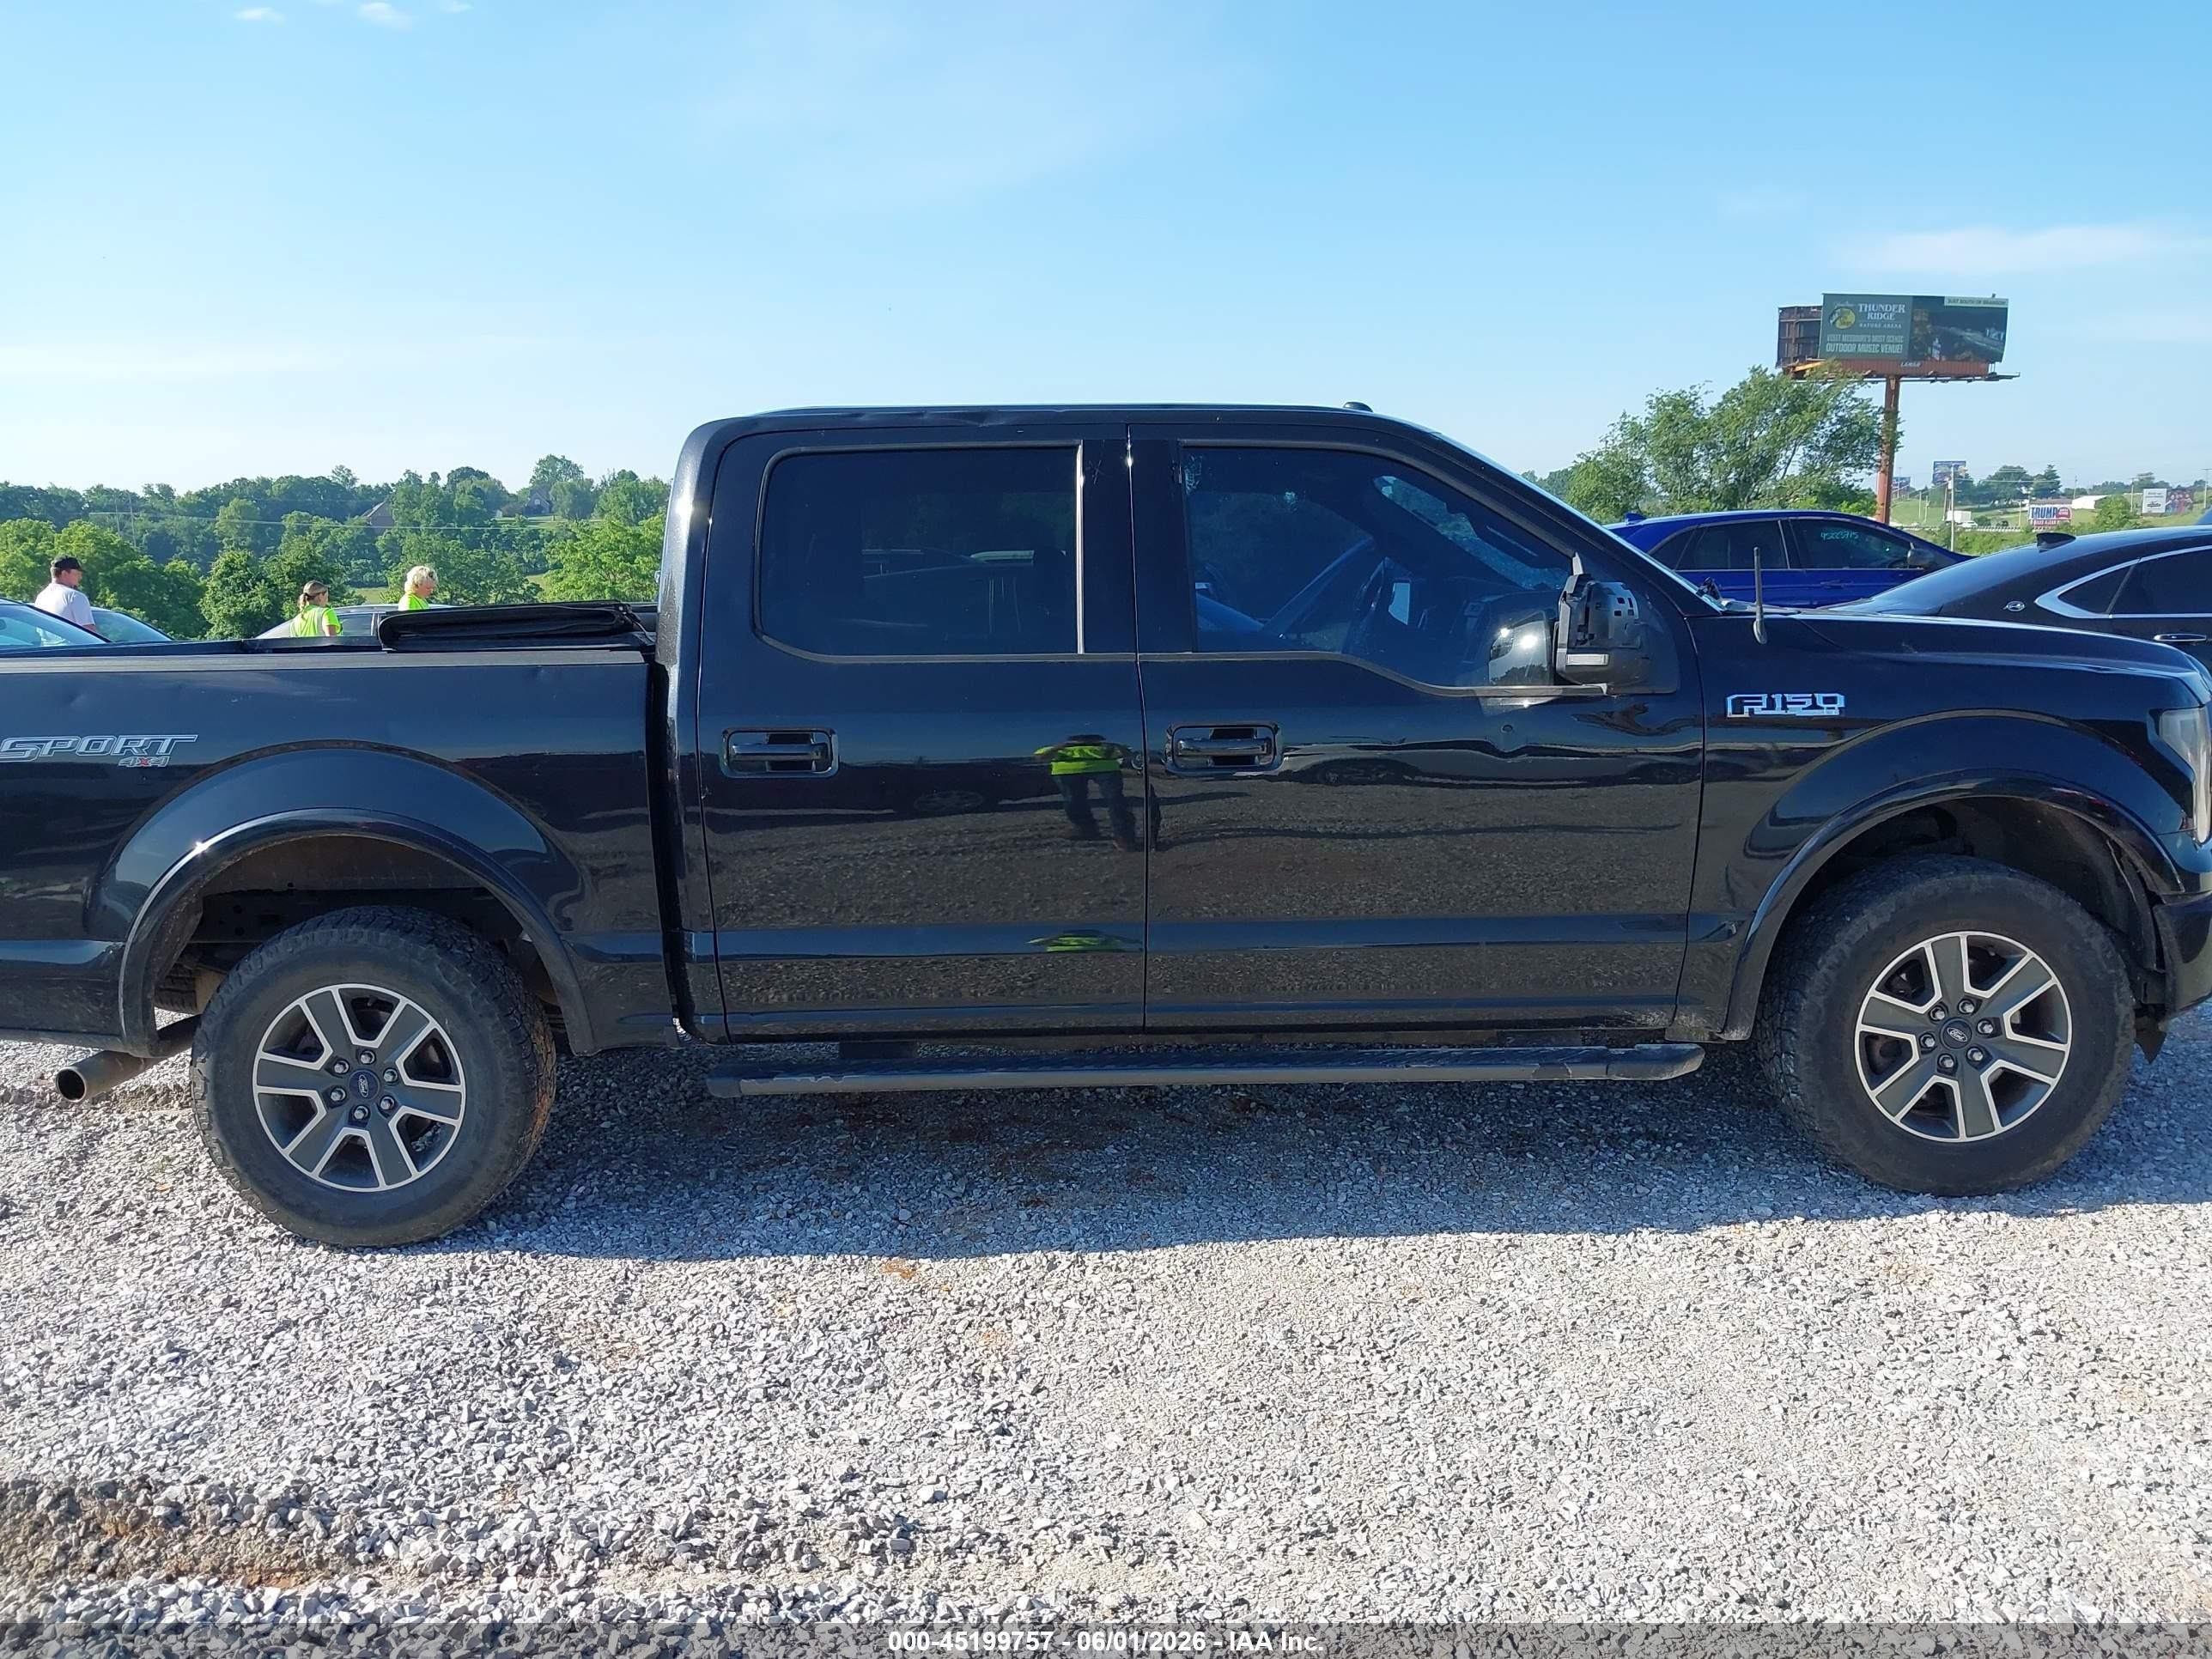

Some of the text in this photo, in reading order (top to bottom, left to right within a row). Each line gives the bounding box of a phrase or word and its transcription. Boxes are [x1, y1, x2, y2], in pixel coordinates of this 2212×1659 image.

[1858, 303, 1905, 313] THUNDER
[1867, 312, 1896, 320] RIDGE
[1826, 343, 1903, 354] OUTDOOR MUSIC VENUE!
[2032, 507, 2058, 518] TRUMP
[1726, 693, 1846, 718] F150
[0, 734, 198, 763] SPORT
[1948, 1029, 1966, 1042] Ford
